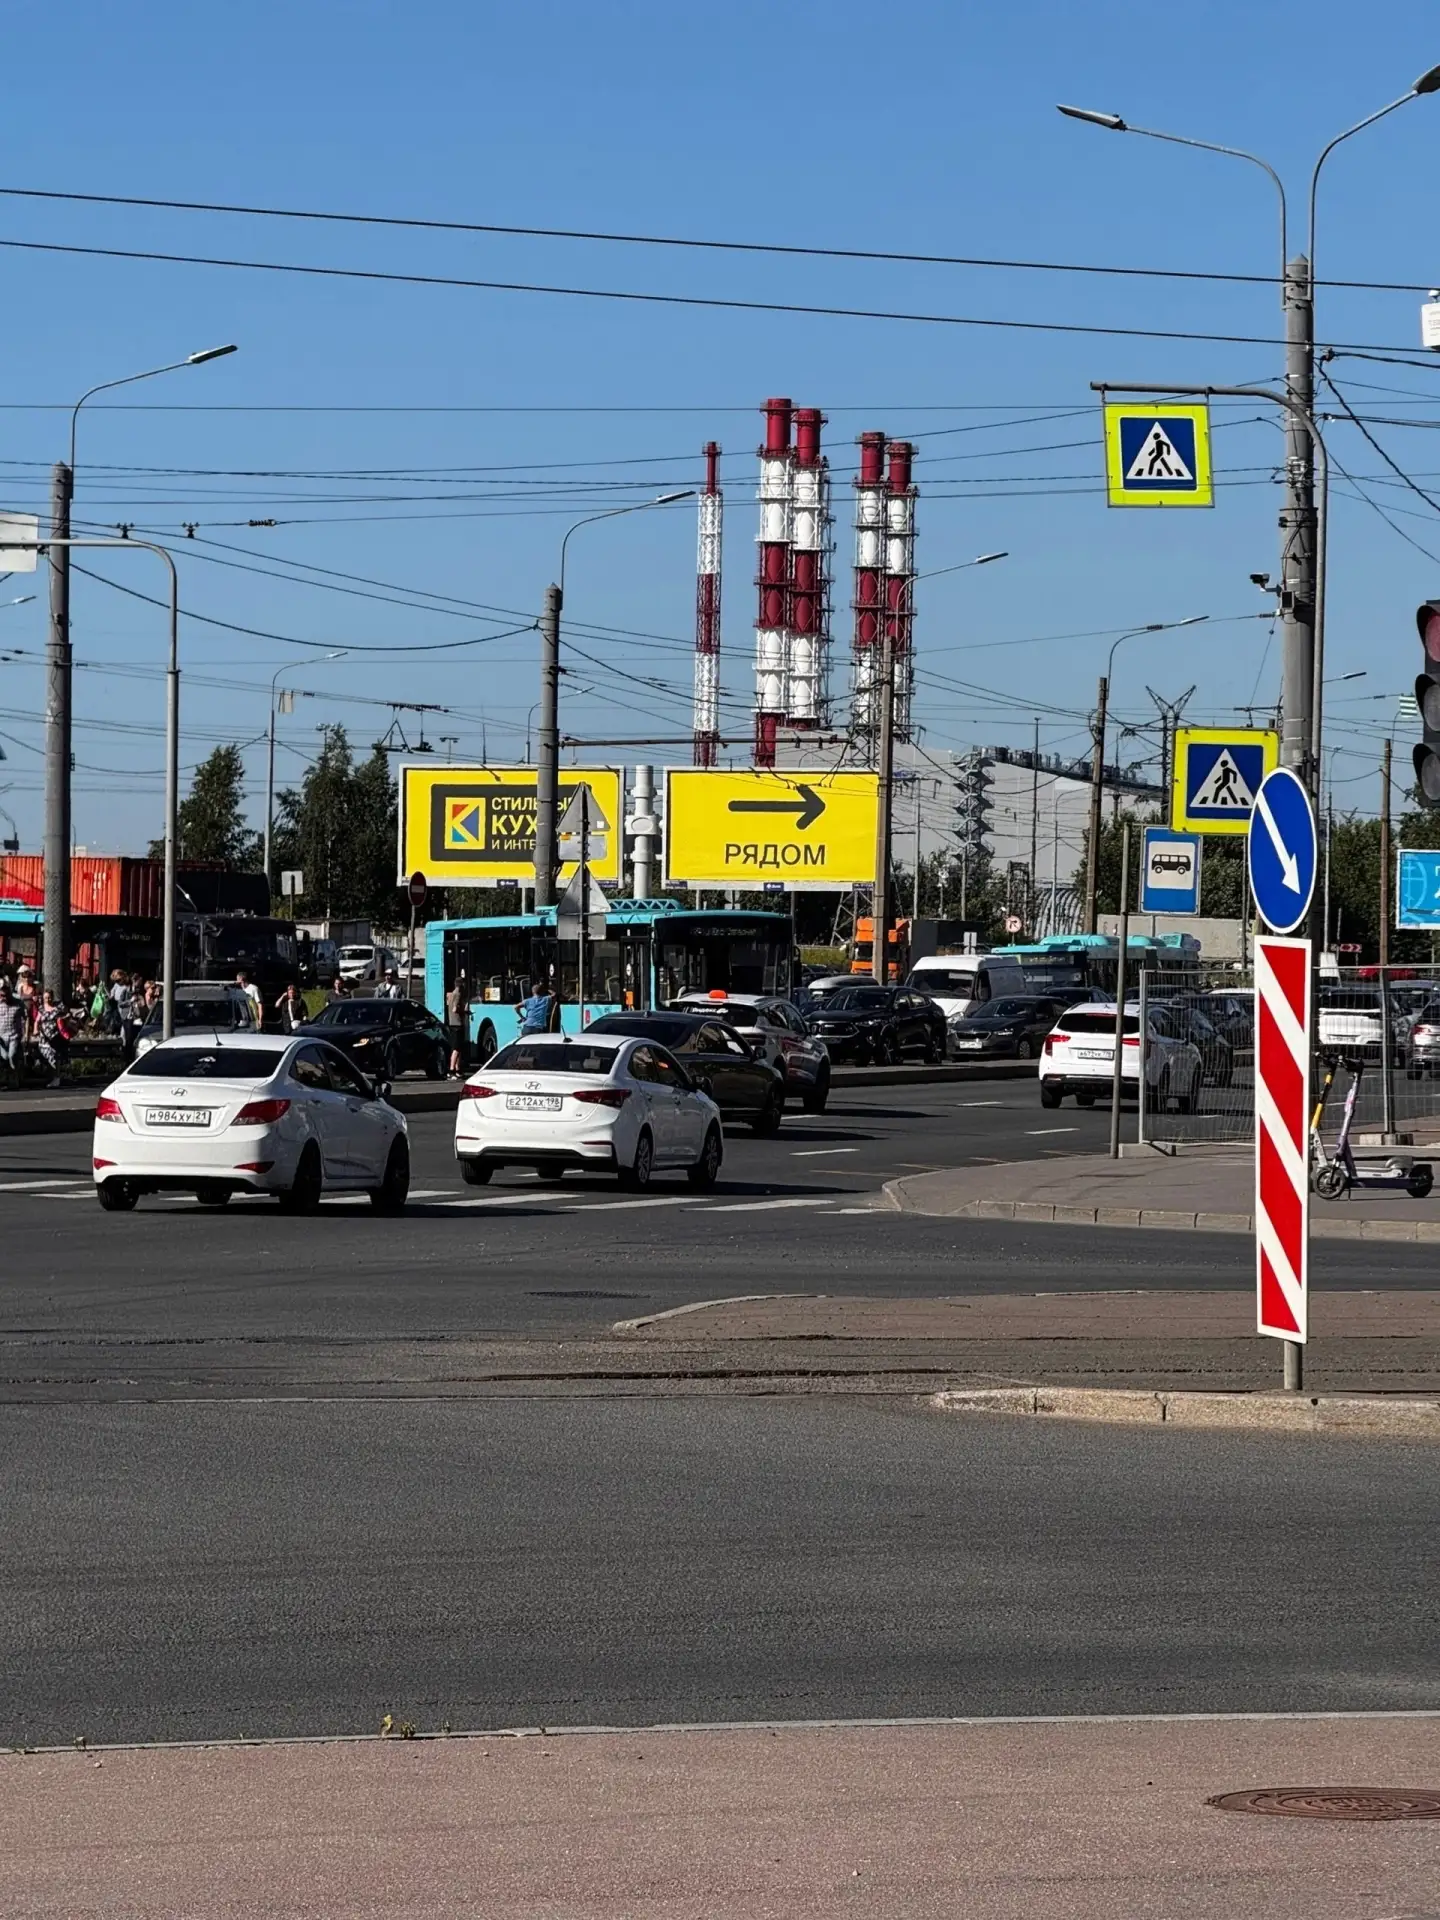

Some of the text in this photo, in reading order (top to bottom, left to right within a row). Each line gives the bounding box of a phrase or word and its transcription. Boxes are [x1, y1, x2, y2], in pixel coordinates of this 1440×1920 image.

[492, 814, 538, 835] КУХ
[492, 839, 537, 851] И ИНТЕ
[725, 844, 825, 868] РЯДОМ
[510, 1097, 543, 1106] Е212АХ
[195, 1111, 206, 1120] 21
